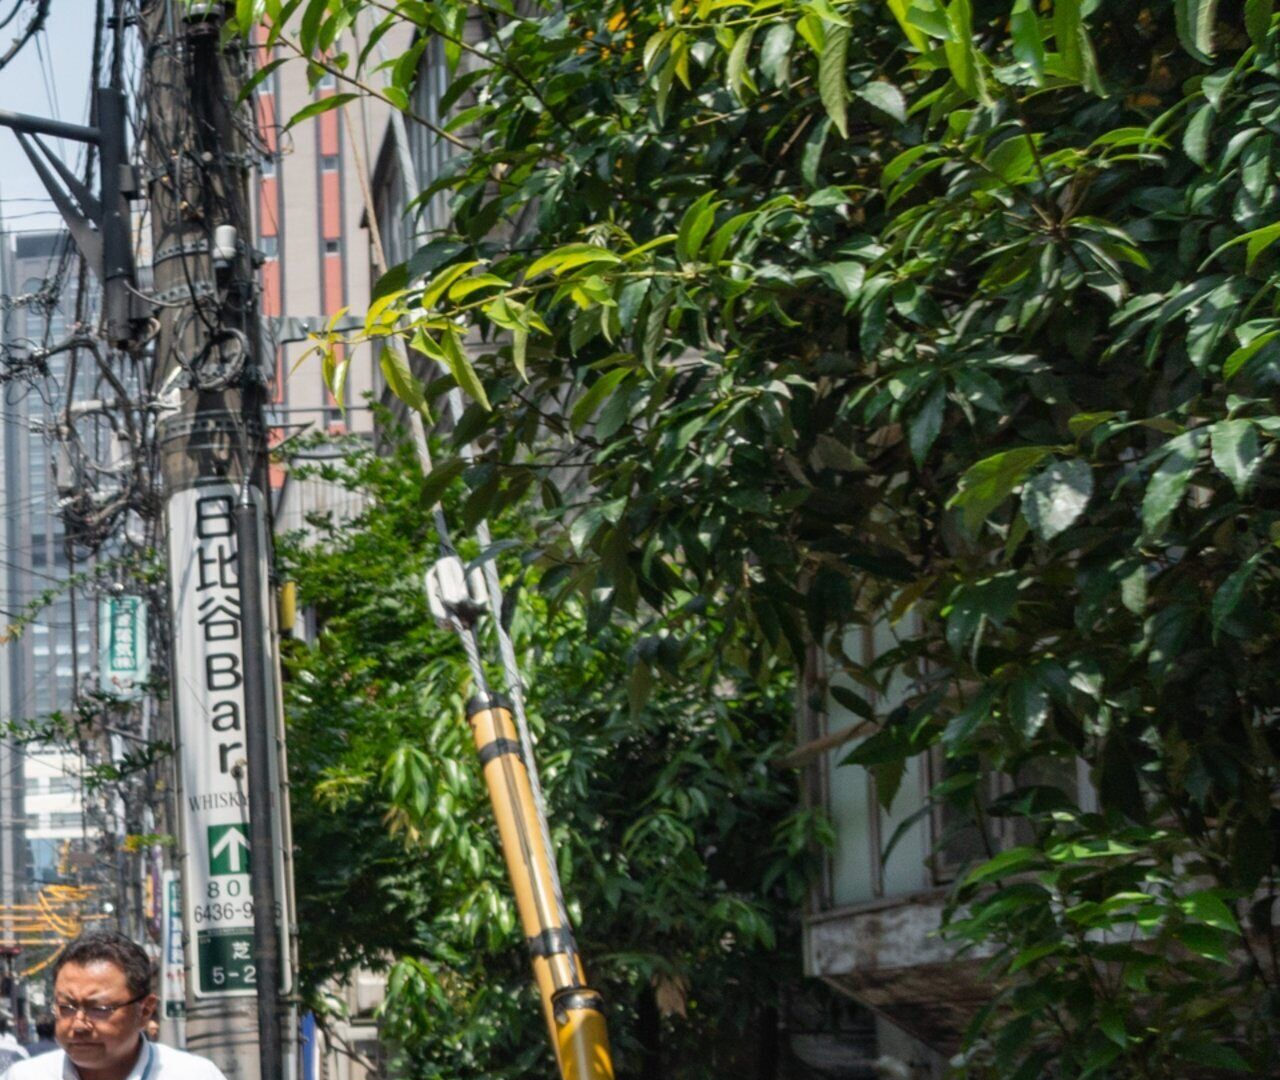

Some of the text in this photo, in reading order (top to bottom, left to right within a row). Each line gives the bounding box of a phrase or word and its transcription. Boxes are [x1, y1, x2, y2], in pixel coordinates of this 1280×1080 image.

[196, 494, 243, 775] 日比谷Bar
[194, 901, 281, 924] 6436-96
[233, 941, 251, 960] 芝
